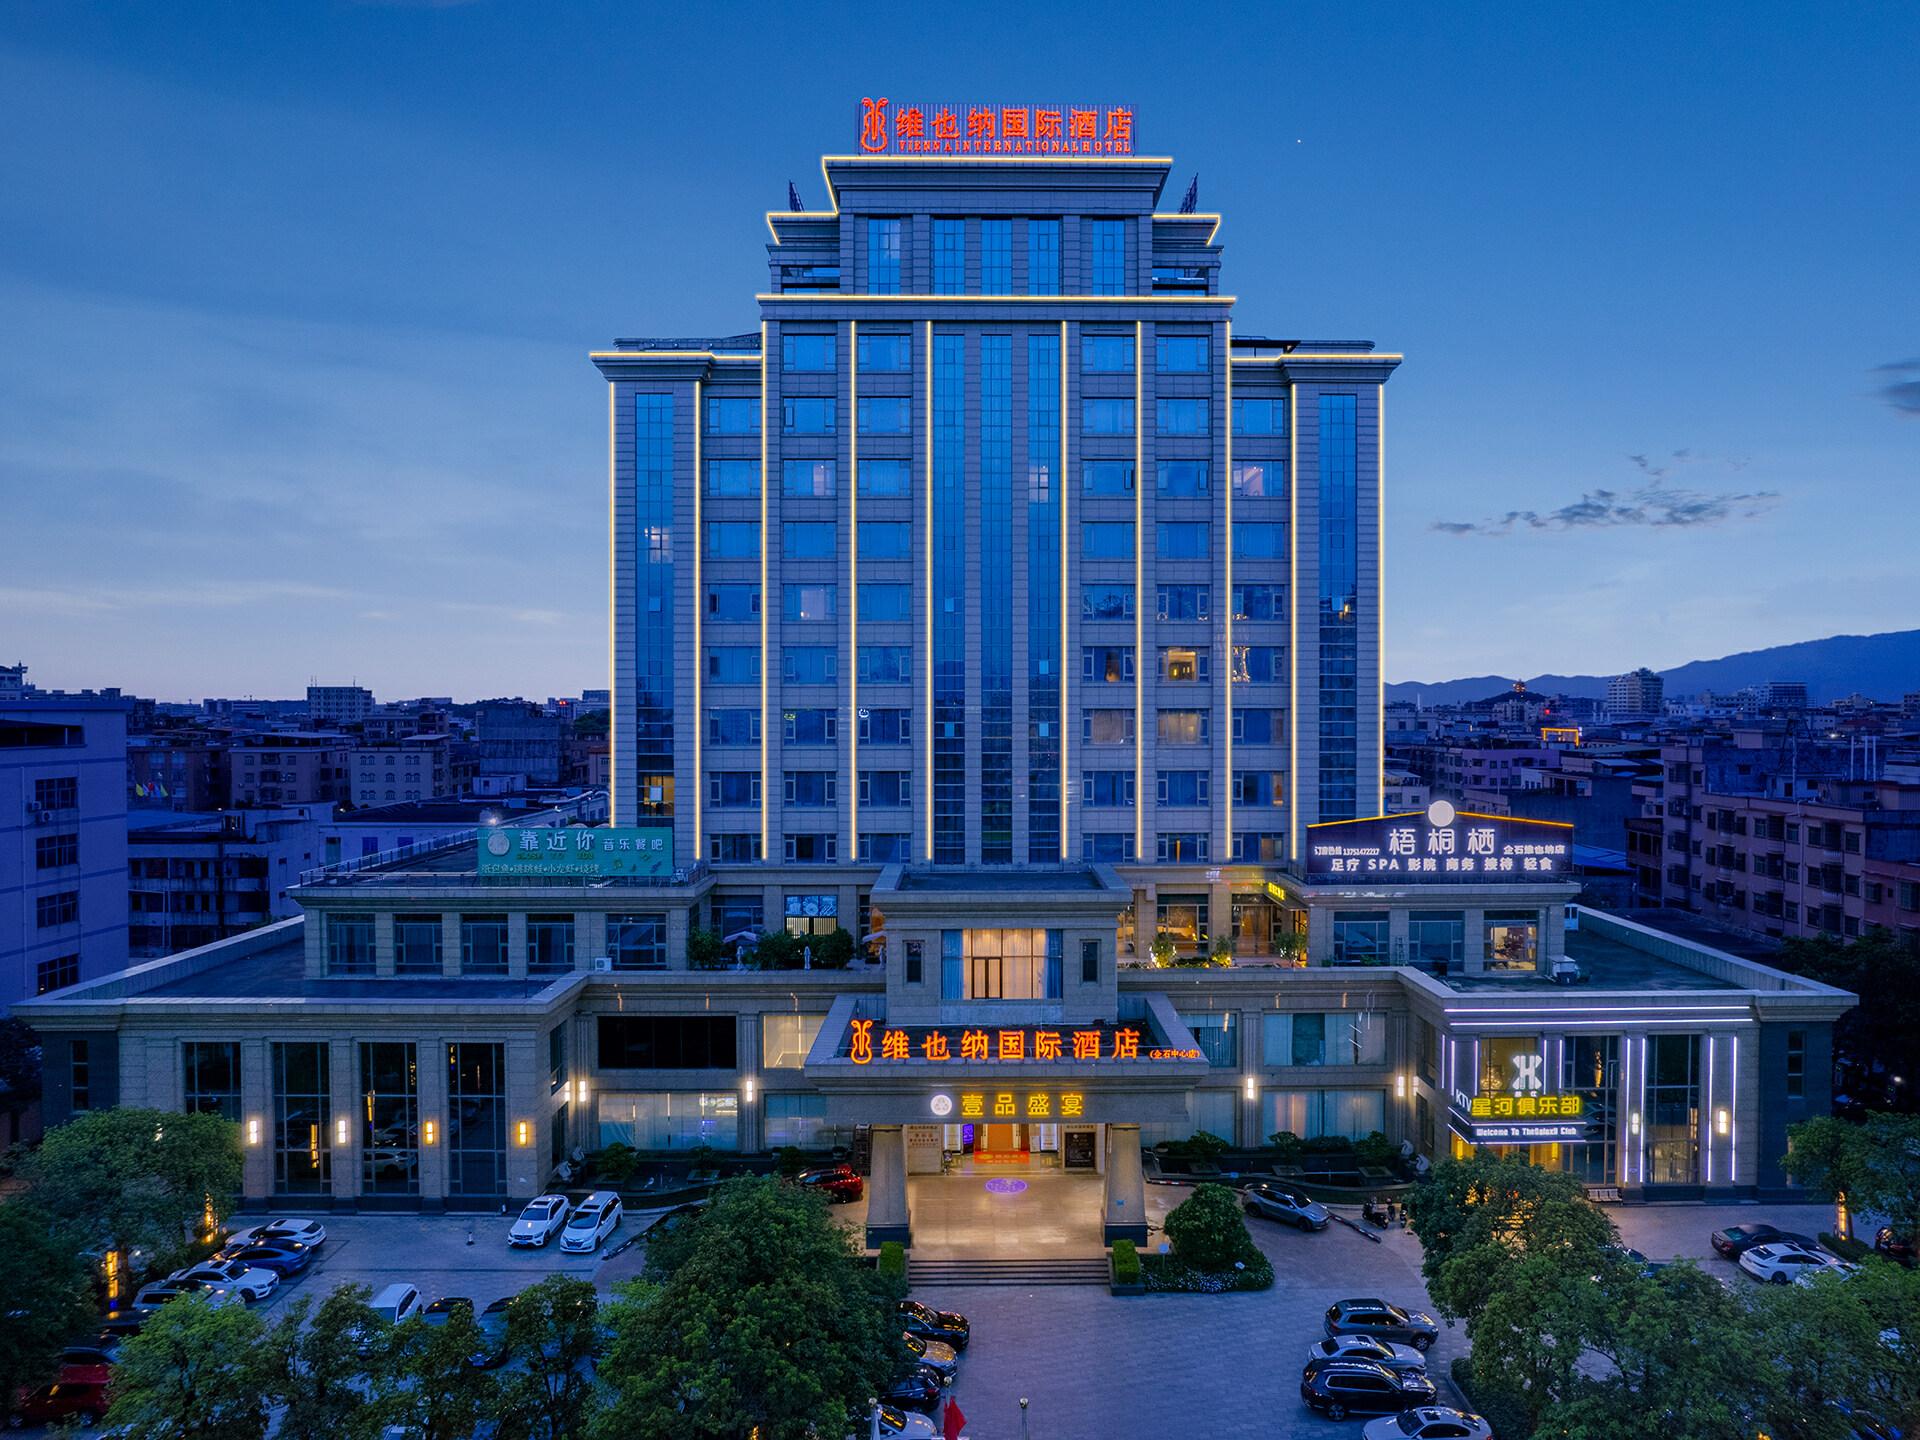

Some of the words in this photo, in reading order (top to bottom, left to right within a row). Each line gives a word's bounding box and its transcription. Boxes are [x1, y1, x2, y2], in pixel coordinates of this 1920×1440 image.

[895, 107, 1133, 140] 维也纳国际酒店
[519, 830, 595, 851] 靠近你
[602, 838, 664, 851] 音乐餐吧
[1388, 828, 1496, 856] 梧桐栖
[1331, 858, 1361, 872] 足疗
[1367, 858, 1400, 871] SPA
[1407, 857, 1437, 872] 影院
[881, 1028, 1140, 1060] 维也纳国际酒店
[962, 1094, 1083, 1116] 壹品盛宴
[1455, 1088, 1472, 1113] KTV
[1471, 1096, 1580, 1117] 星河俱乐部
[1476, 1128, 1509, 1137] Welcome
[1511, 1128, 1520, 1136] To
